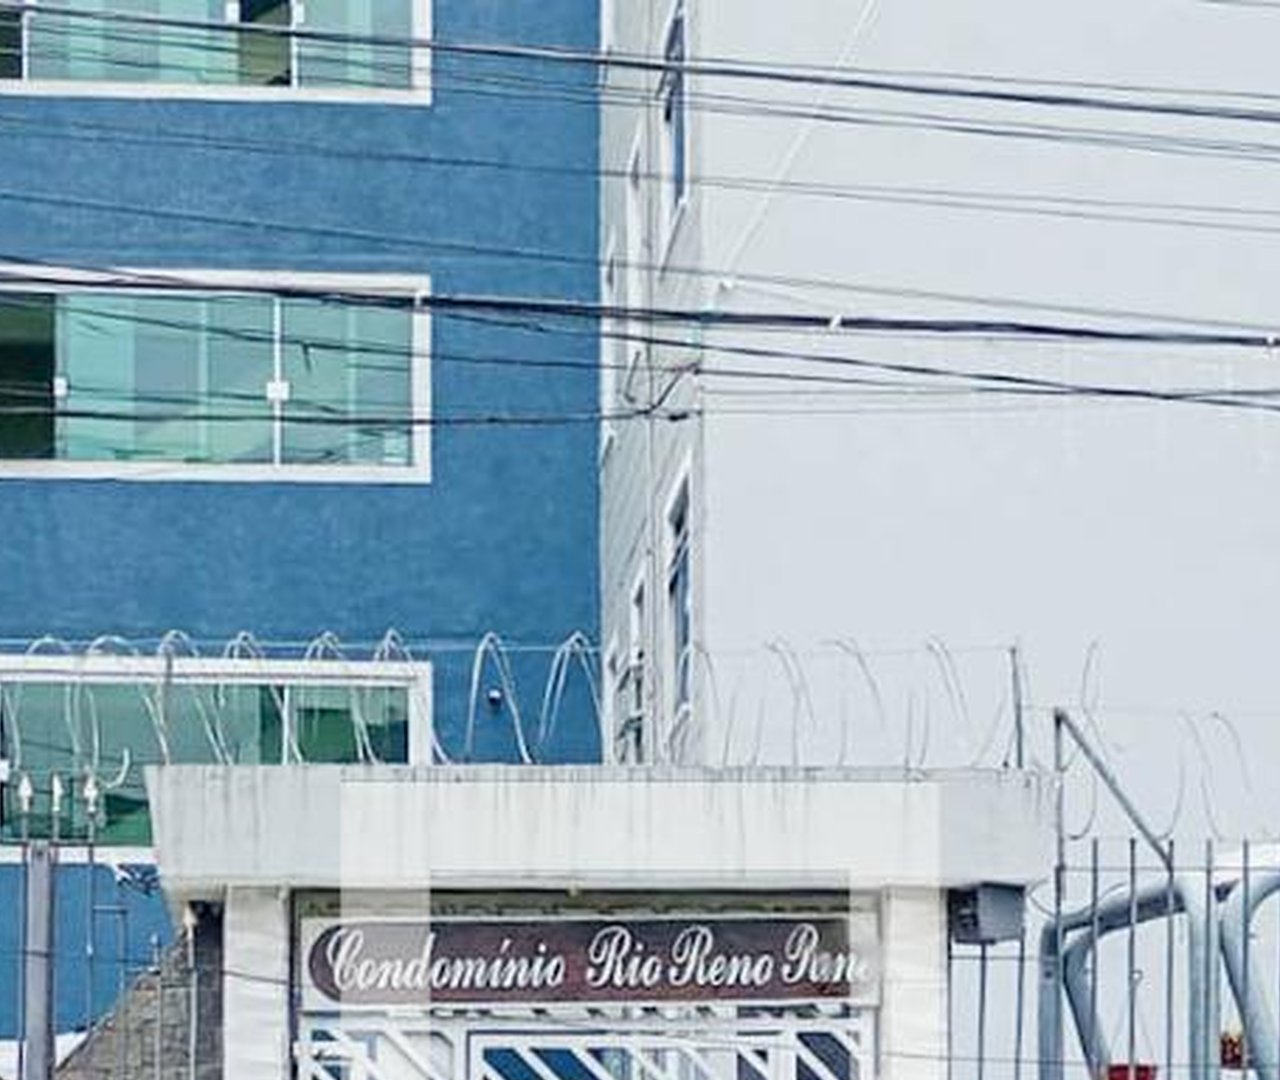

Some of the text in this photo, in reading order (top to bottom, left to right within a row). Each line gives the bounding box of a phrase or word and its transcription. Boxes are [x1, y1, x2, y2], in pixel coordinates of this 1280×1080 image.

[326, 928, 566, 990] Condomínio
[586, 925, 663, 987] Rio
[670, 924, 774, 986] Reno
